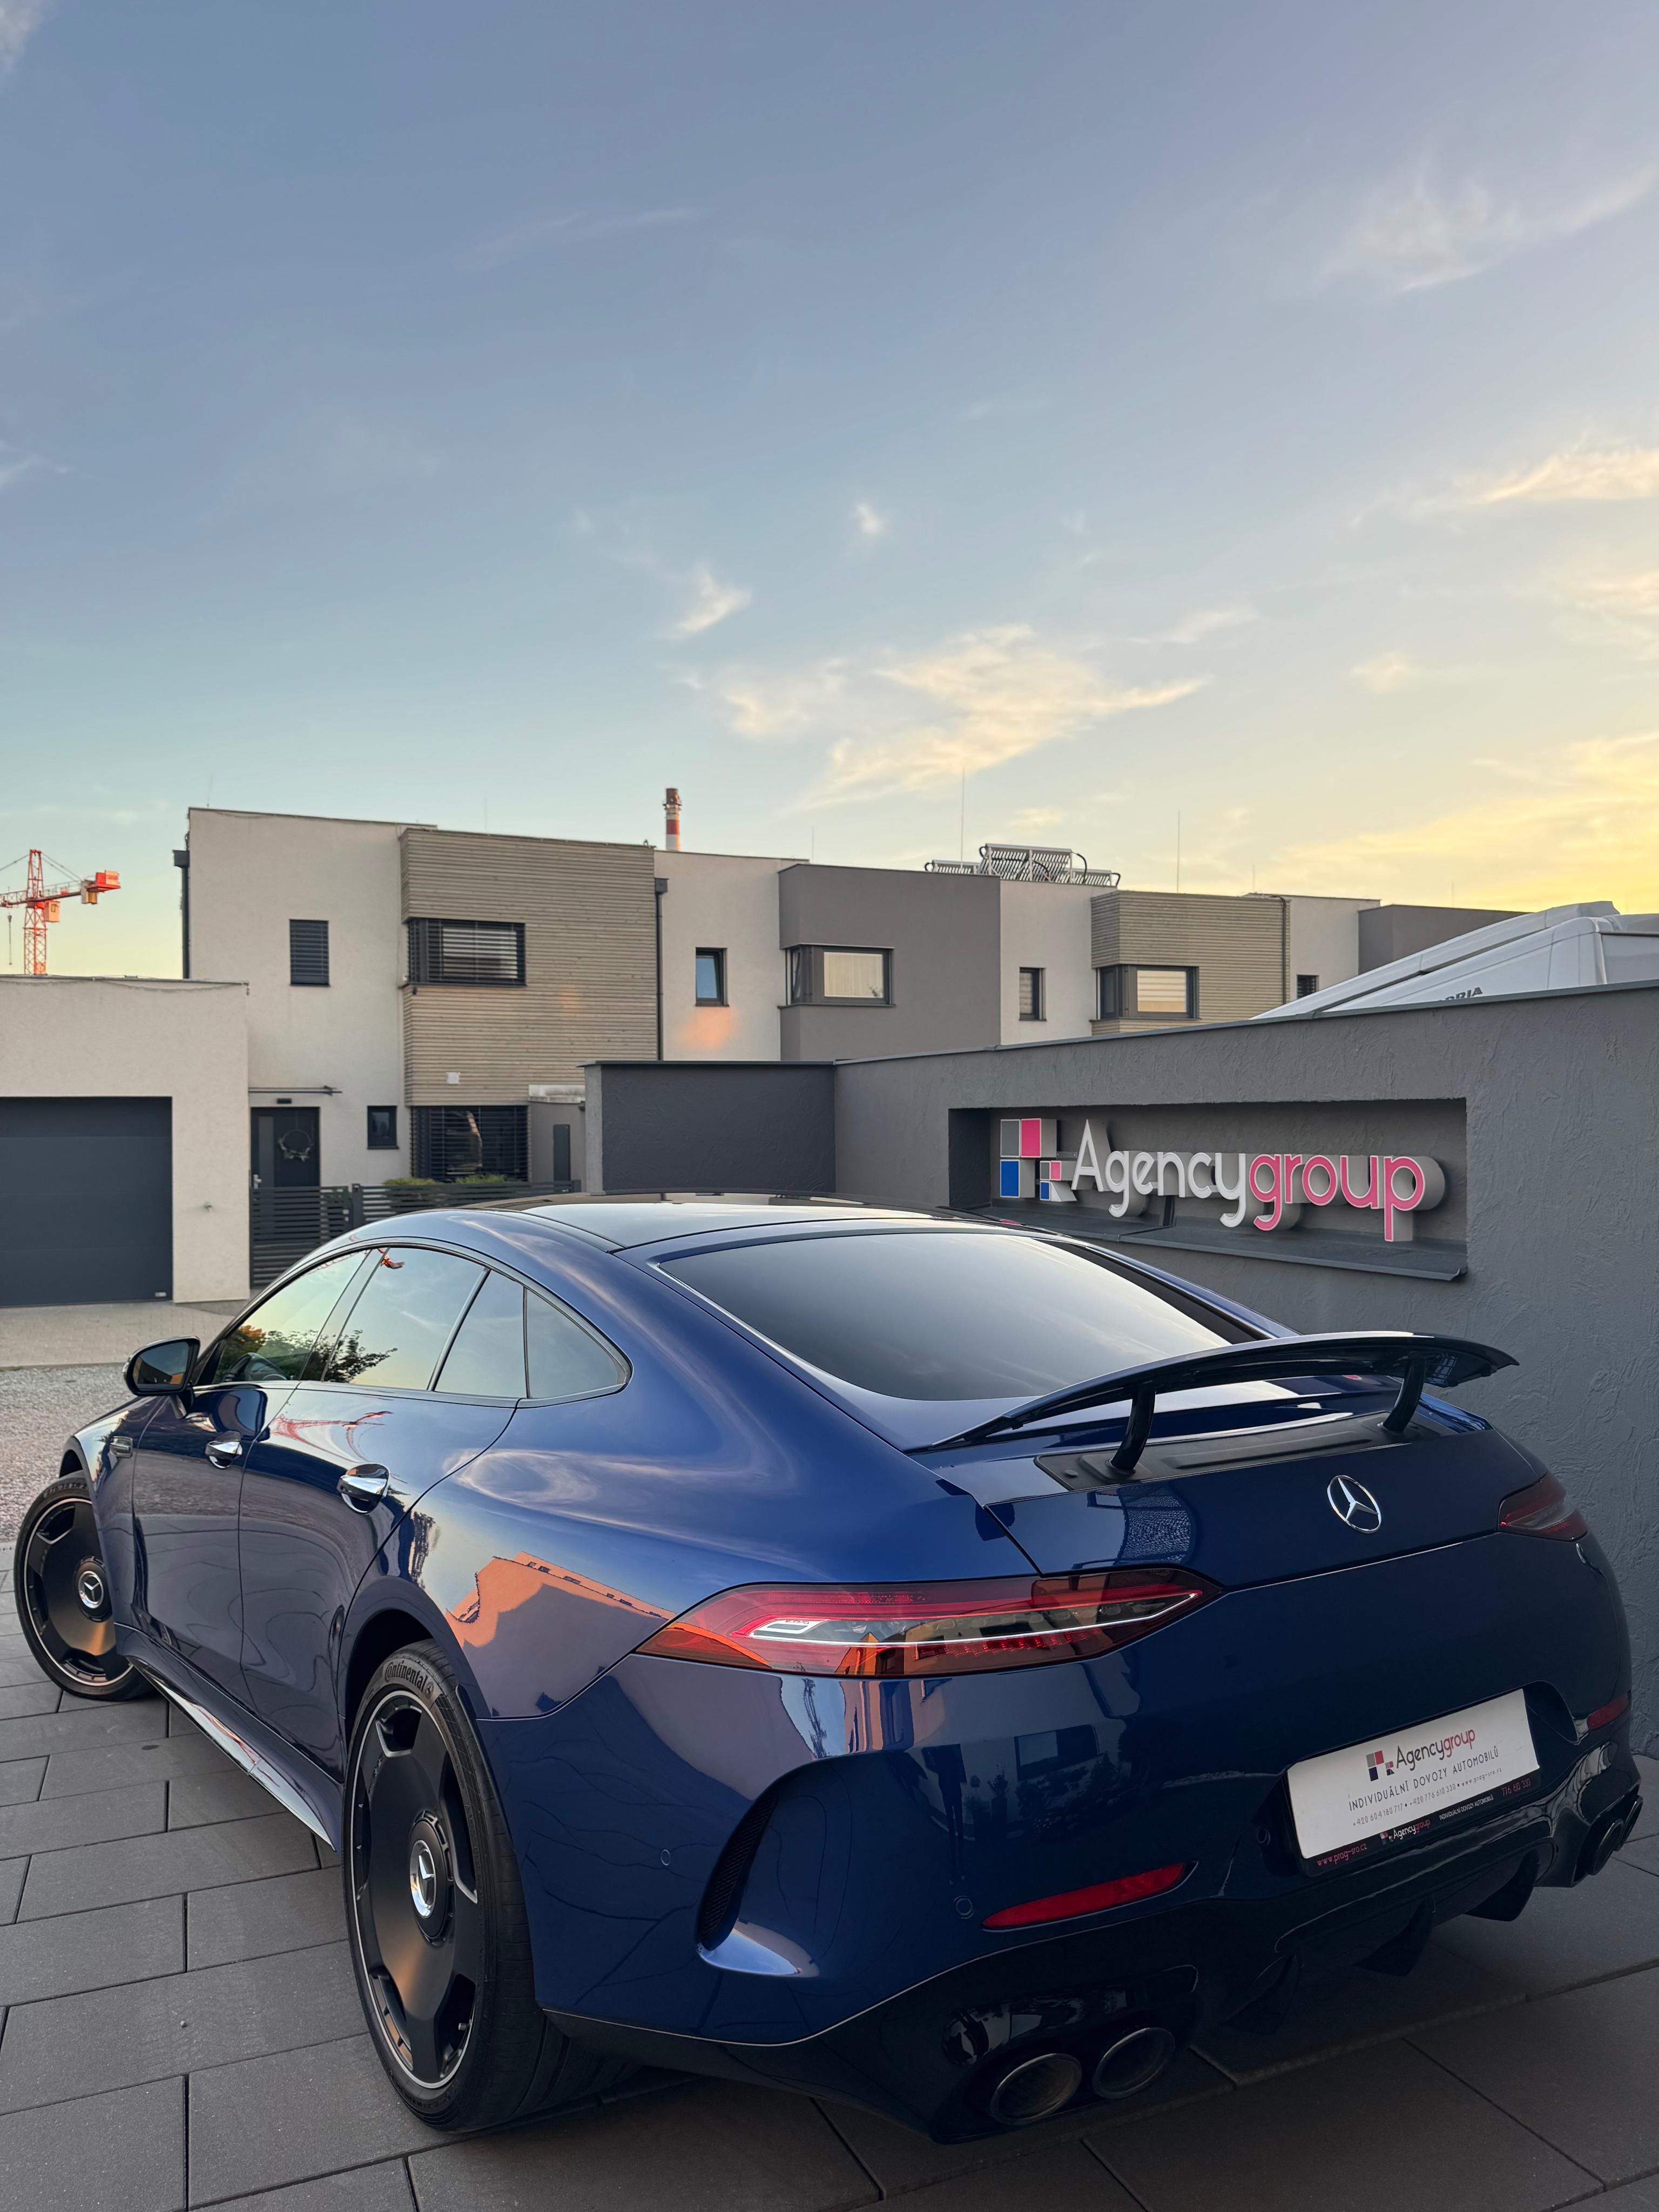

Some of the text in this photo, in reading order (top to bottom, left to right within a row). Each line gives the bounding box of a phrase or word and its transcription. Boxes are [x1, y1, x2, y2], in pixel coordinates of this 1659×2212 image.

[1440, 987, 1483, 1001] RIA
[1071, 1118, 1426, 1243] Agencygroup
[385, 1660, 428, 1693] Continental
[1396, 1729, 1475, 1771] Agencygroup
[1348, 1745, 1499, 1811] INDIVIDUÁLNÍ DOVOZY AUTOMOBILŮ
[1317, 1843, 1368, 1866] www.prag-sro.cz
[1393, 1819, 1431, 1840] Agencygroup
